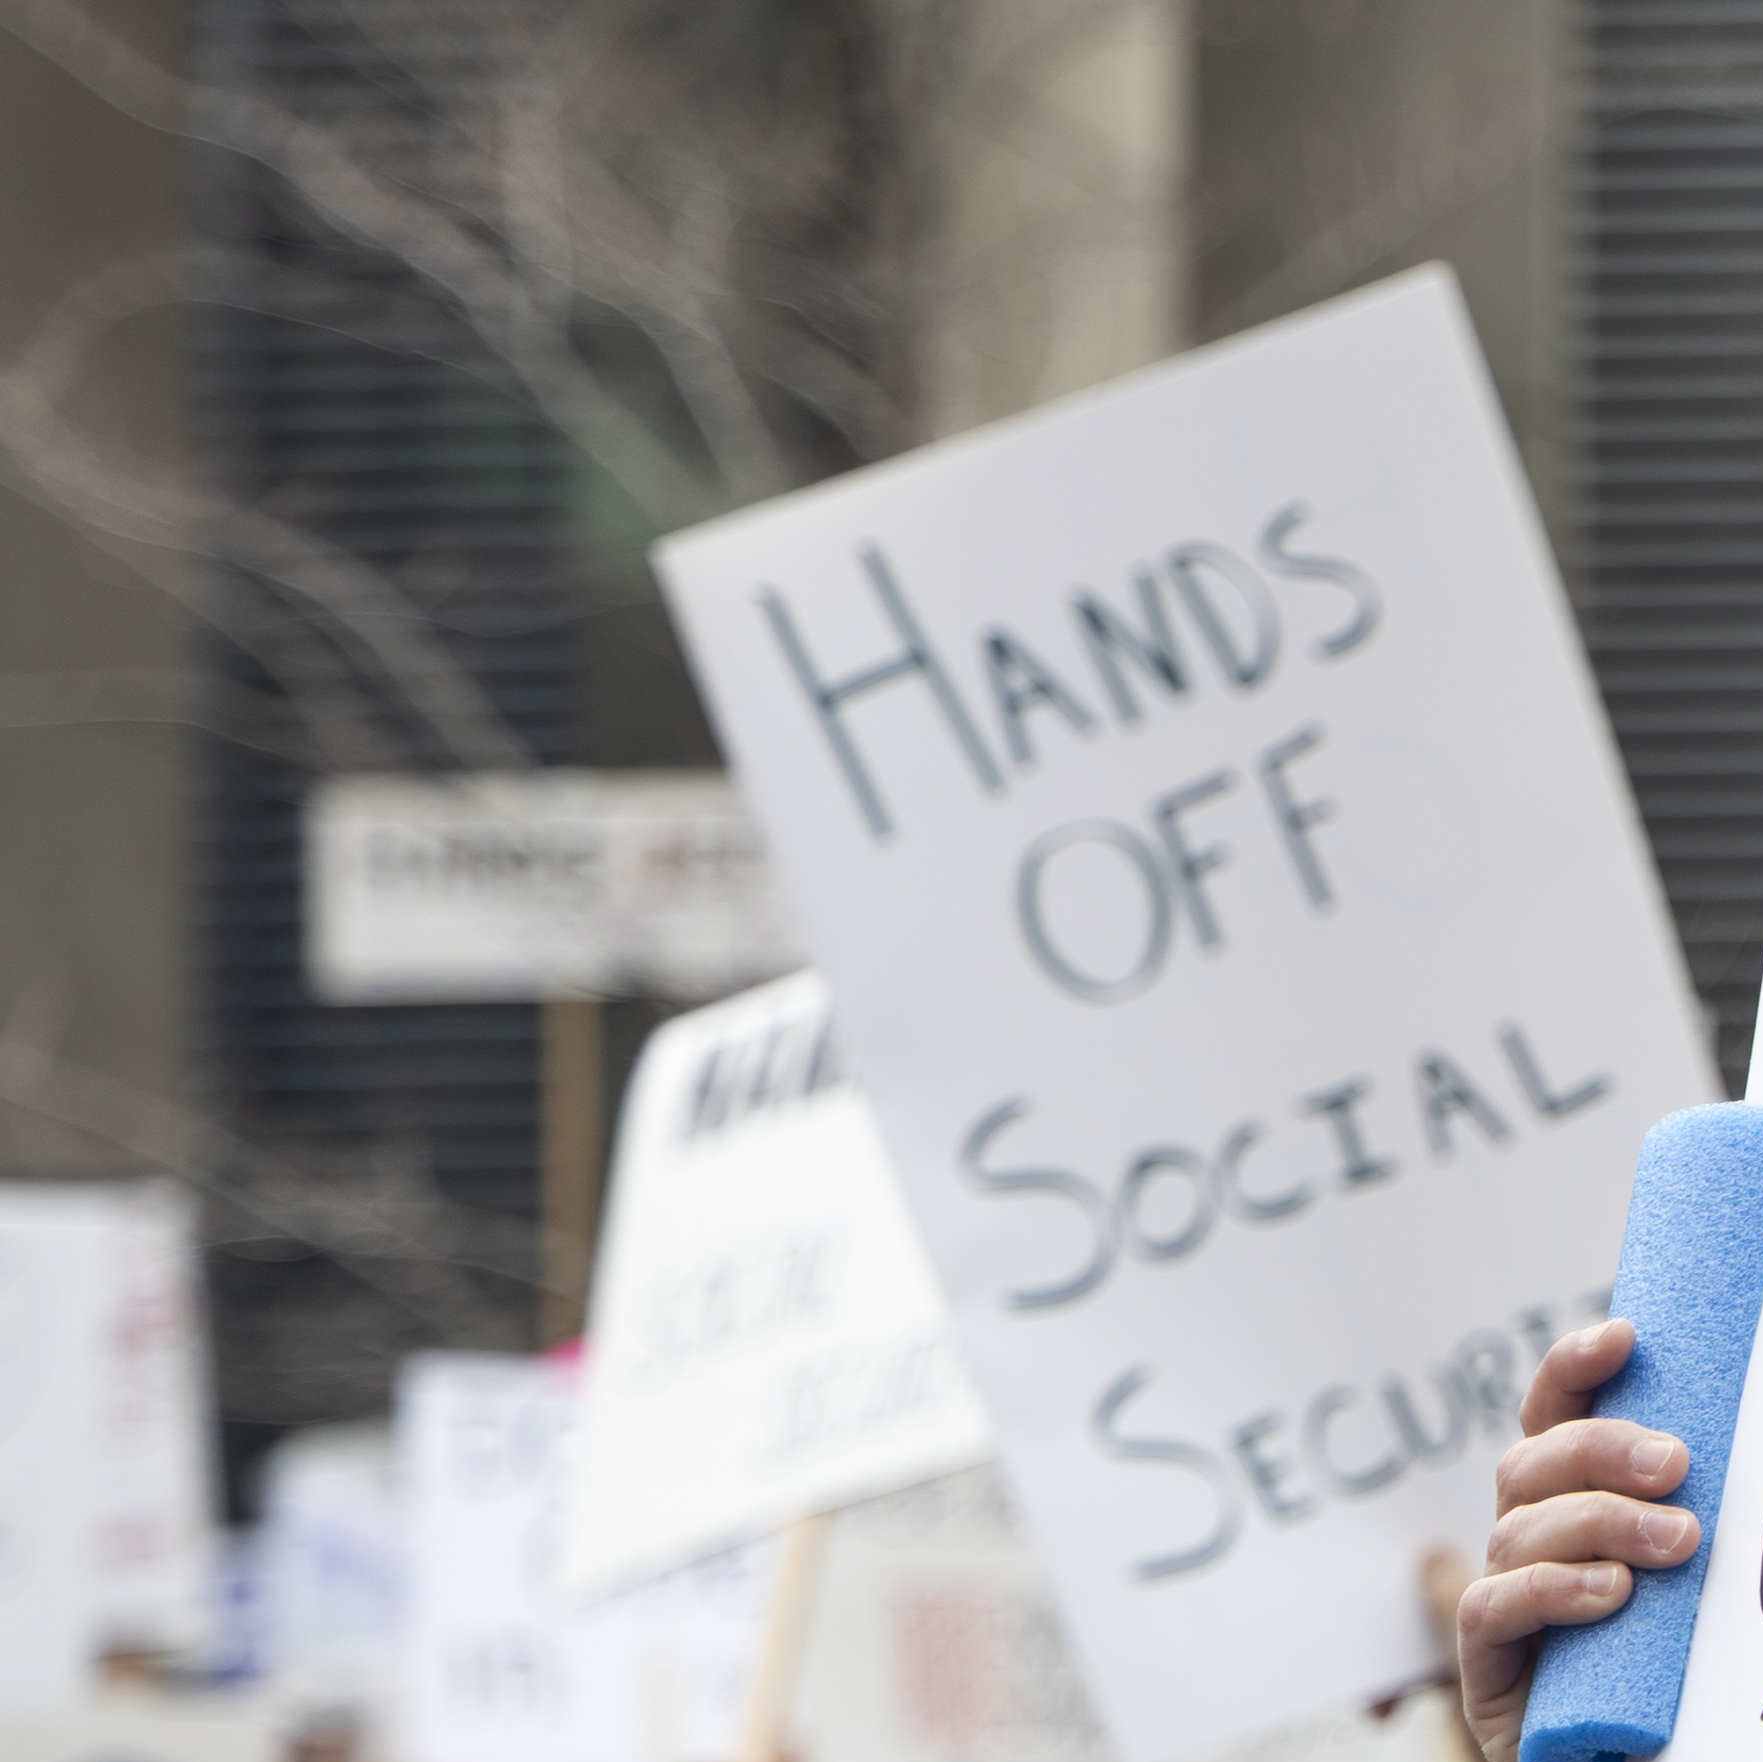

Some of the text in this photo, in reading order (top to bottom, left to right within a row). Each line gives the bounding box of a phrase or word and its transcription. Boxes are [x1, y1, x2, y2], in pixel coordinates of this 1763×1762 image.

[755, 501, 1383, 844] HANDS
[1015, 720, 1340, 1003] OFF
[957, 1018, 1616, 1316] SOCIAL
